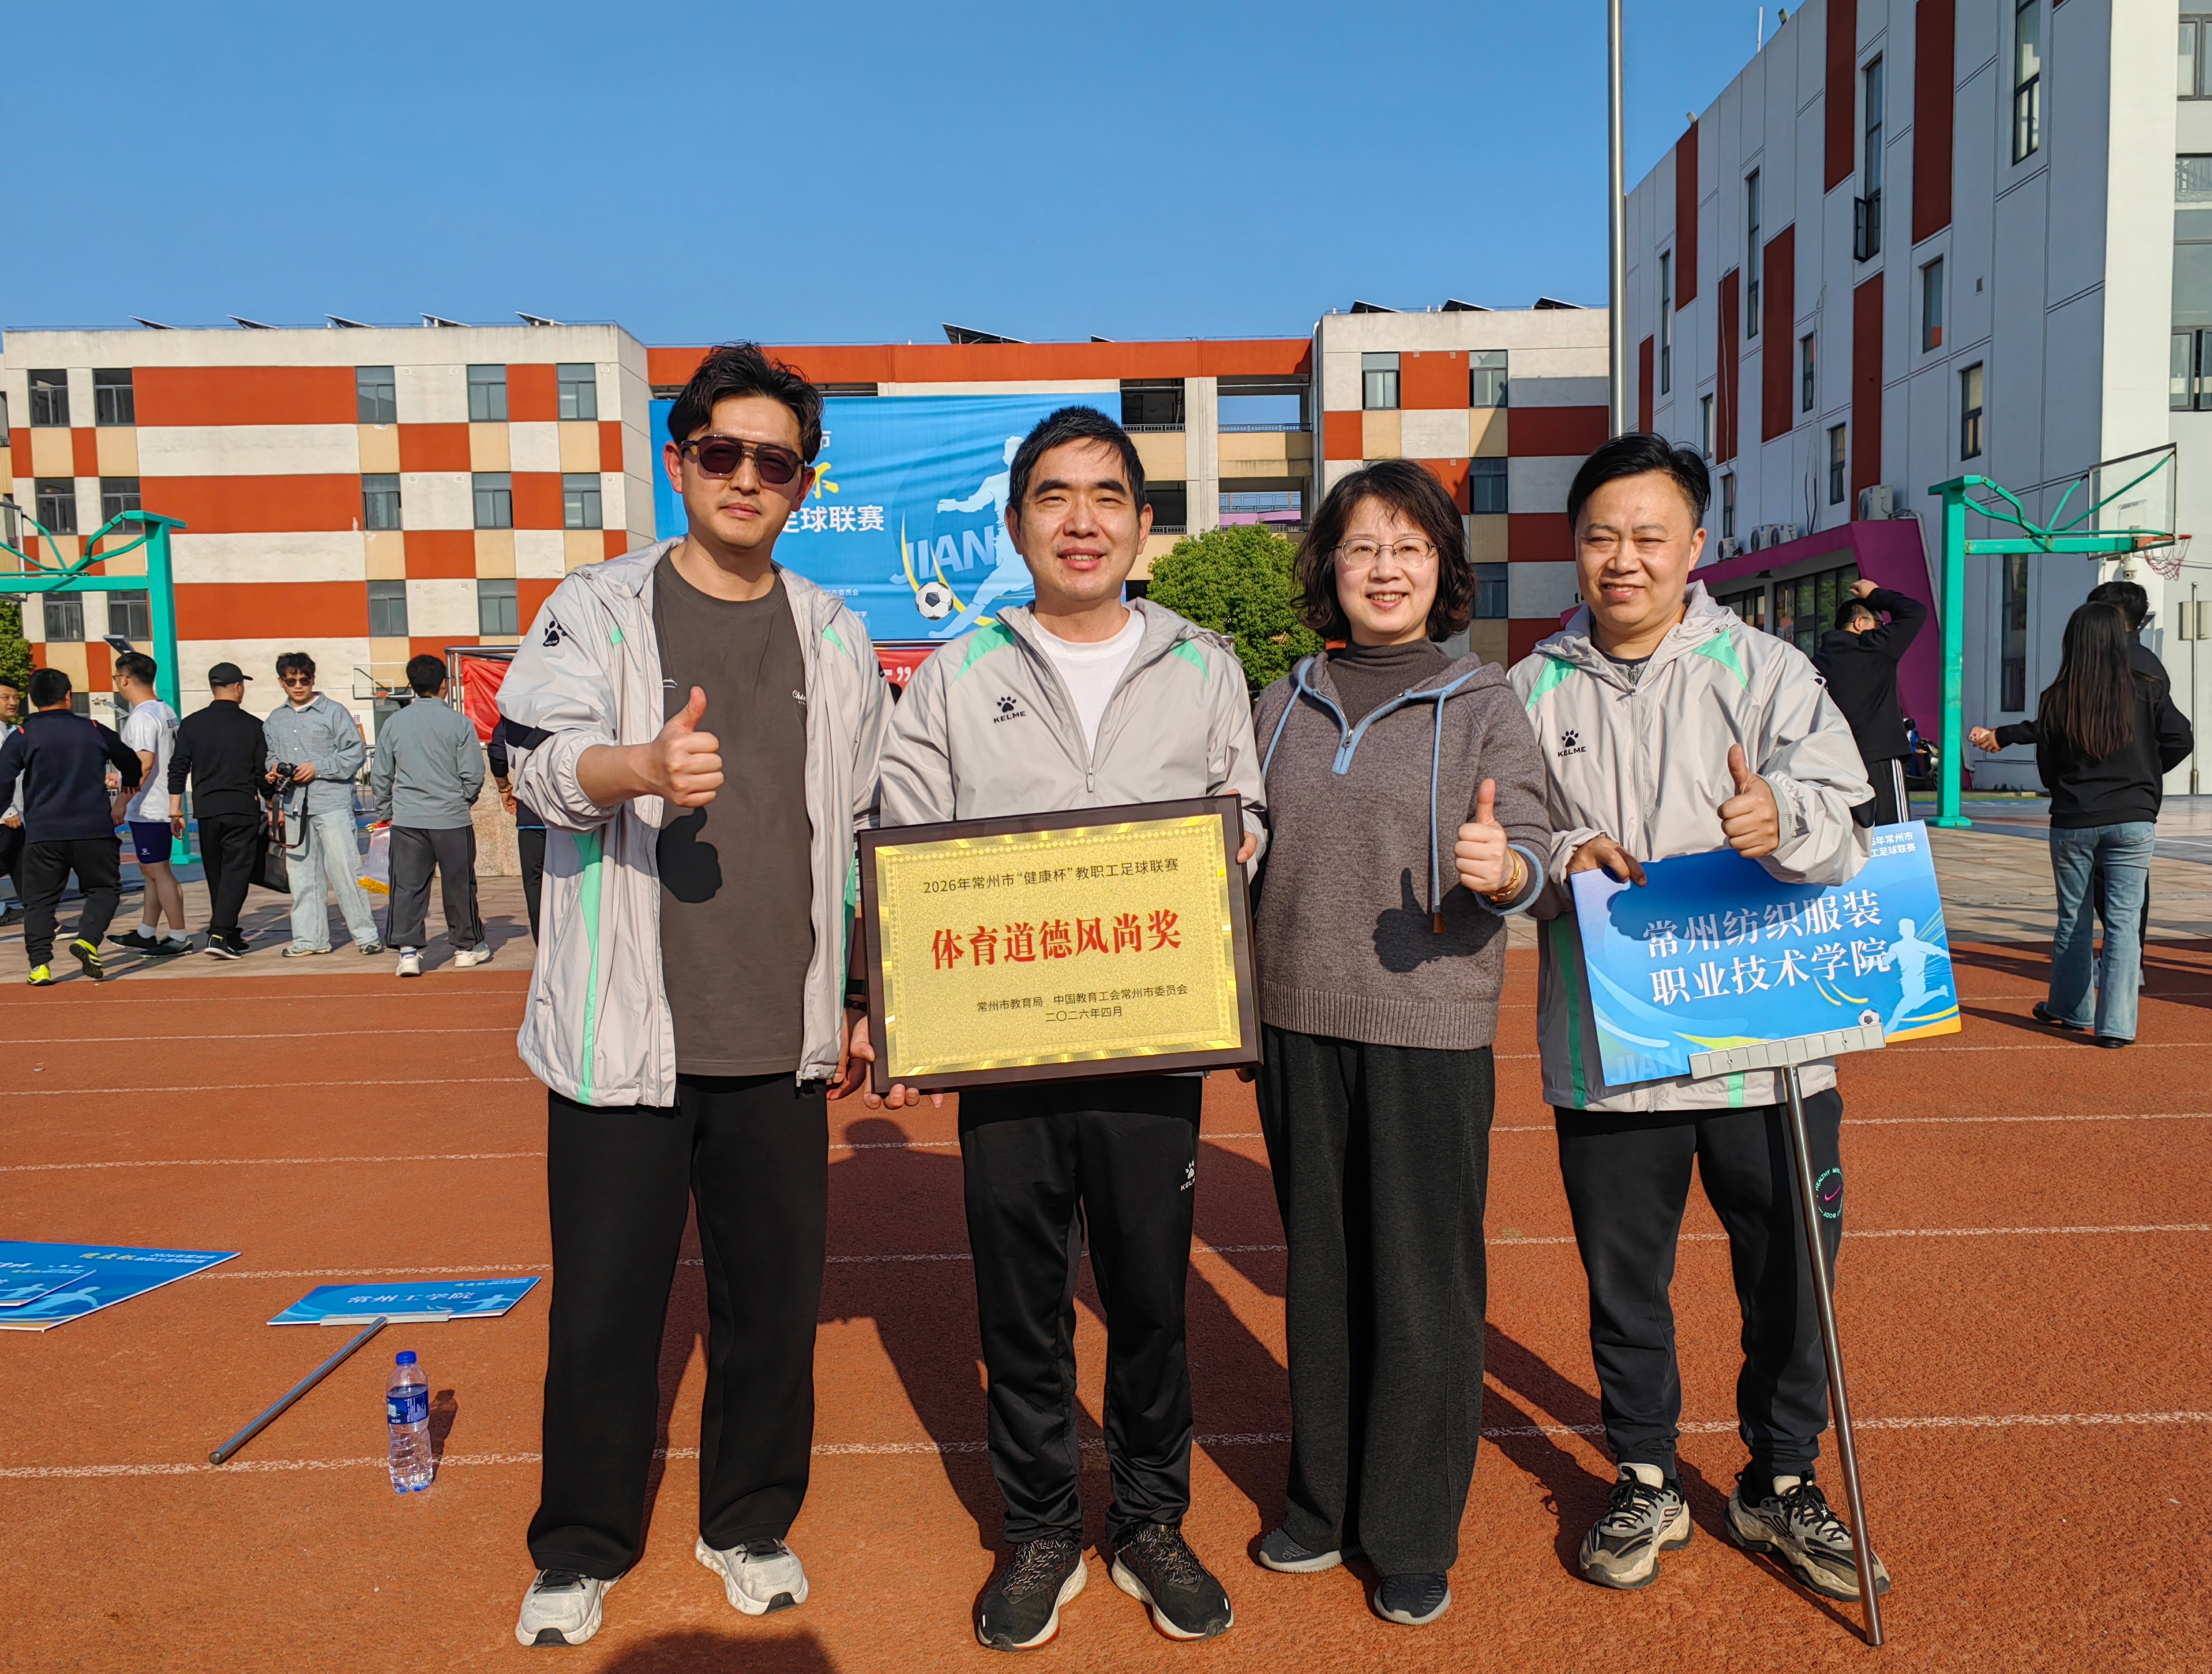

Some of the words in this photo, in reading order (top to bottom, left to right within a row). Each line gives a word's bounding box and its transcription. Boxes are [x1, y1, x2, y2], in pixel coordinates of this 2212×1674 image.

[993, 711, 1027, 724] KELME
[1557, 746, 1587, 758] KELME
[1643, 889, 1882, 959] 常州纺织服装
[930, 908, 1181, 970] 体育道德风尚奖
[1648, 937, 1892, 1006] 职业技术学院
[976, 995, 1043, 1012] 常州市教育局
[1053, 983, 1188, 1006] 中国教育工会常州市委员会
[347, 1292, 475, 1304] 常州工学院
